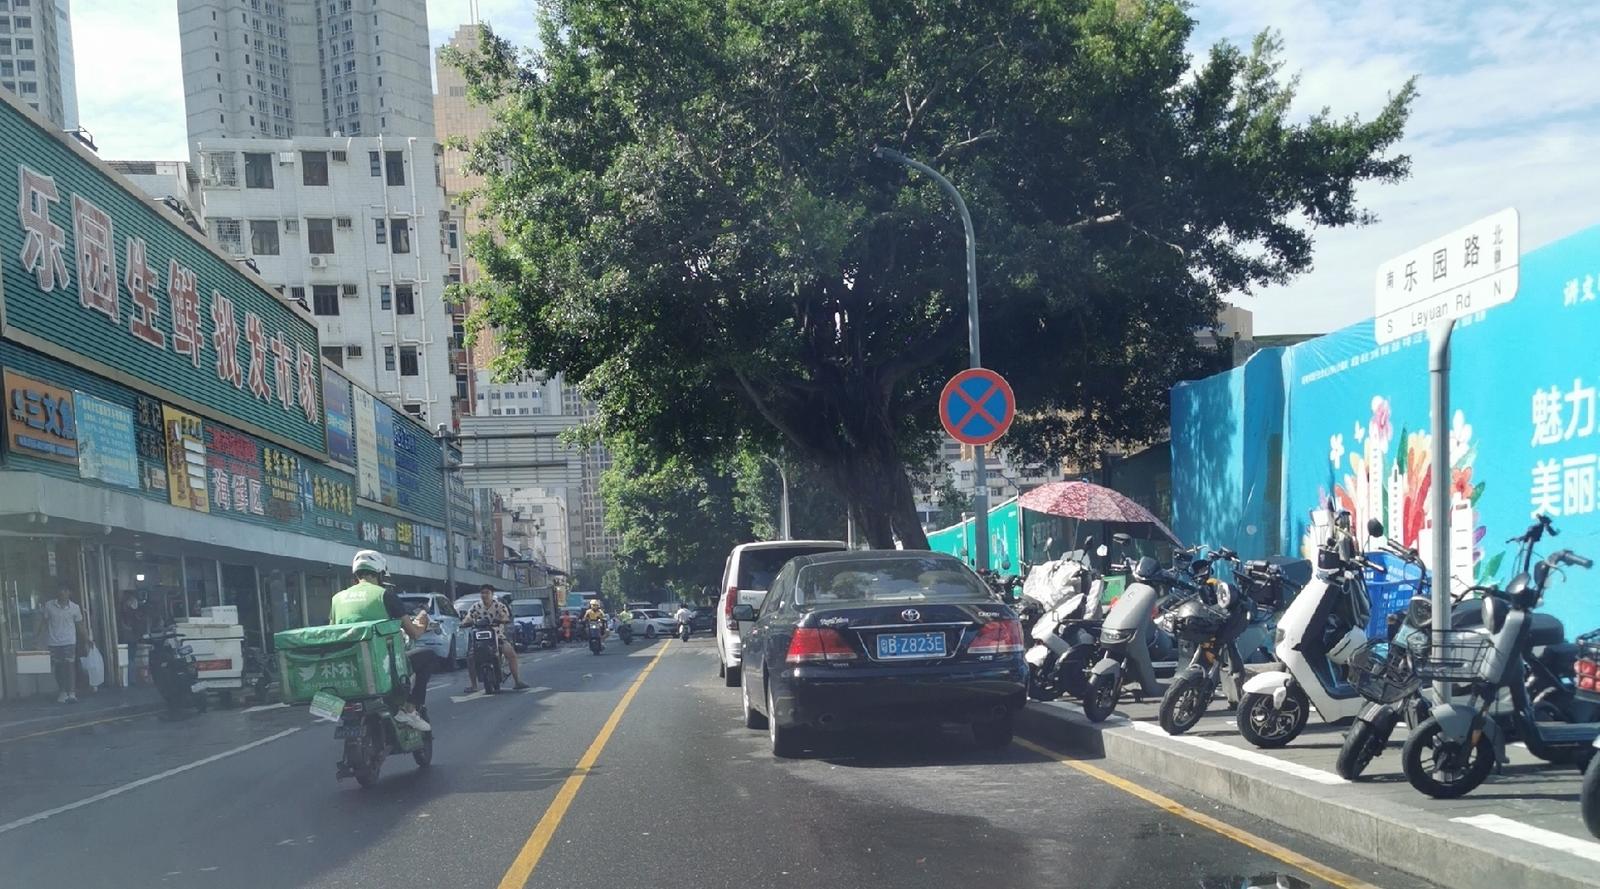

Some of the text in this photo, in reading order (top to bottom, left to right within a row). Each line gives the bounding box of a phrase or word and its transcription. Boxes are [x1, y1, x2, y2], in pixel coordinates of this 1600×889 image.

[1403, 233, 1480, 292] 乐园路
[18, 164, 318, 424] 乐园生鲜批发市场
[1387, 318, 1393, 334] S
[1411, 301, 1448, 327] Leyuan
[1456, 292, 1471, 311] Rd
[1493, 280, 1502, 297] N
[1532, 378, 1600, 446] 魅力
[1531, 454, 1600, 517] 美丽
[320, 661, 357, 679] 朴朴
